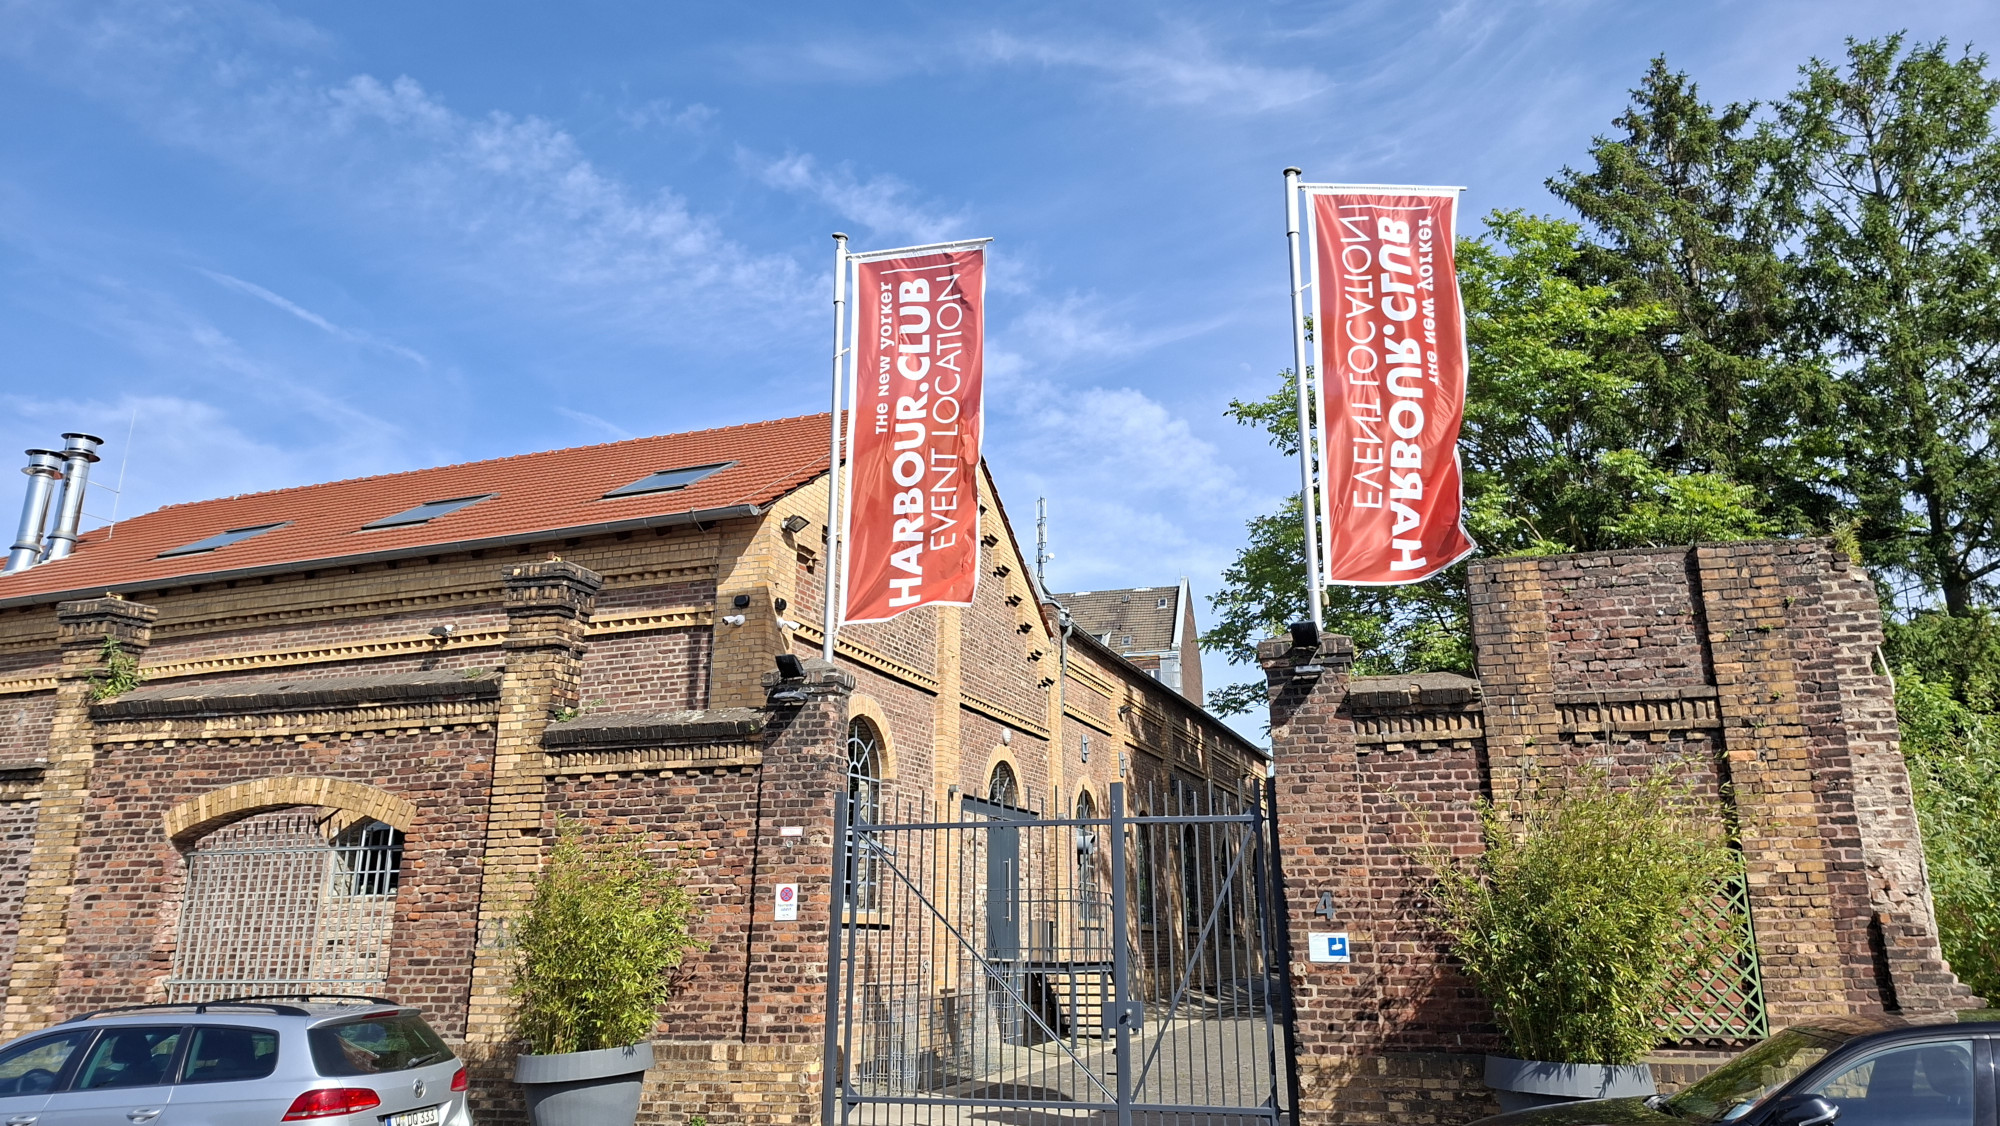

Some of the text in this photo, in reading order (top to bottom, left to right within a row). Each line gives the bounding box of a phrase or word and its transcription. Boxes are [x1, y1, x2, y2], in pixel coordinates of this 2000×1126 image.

[888, 277, 931, 608] HARBOUR.CLUB
[930, 273, 963, 551] EVENT LOCATION
[1315, 891, 1336, 920] 4
[420, 1109, 435, 1124] 333
